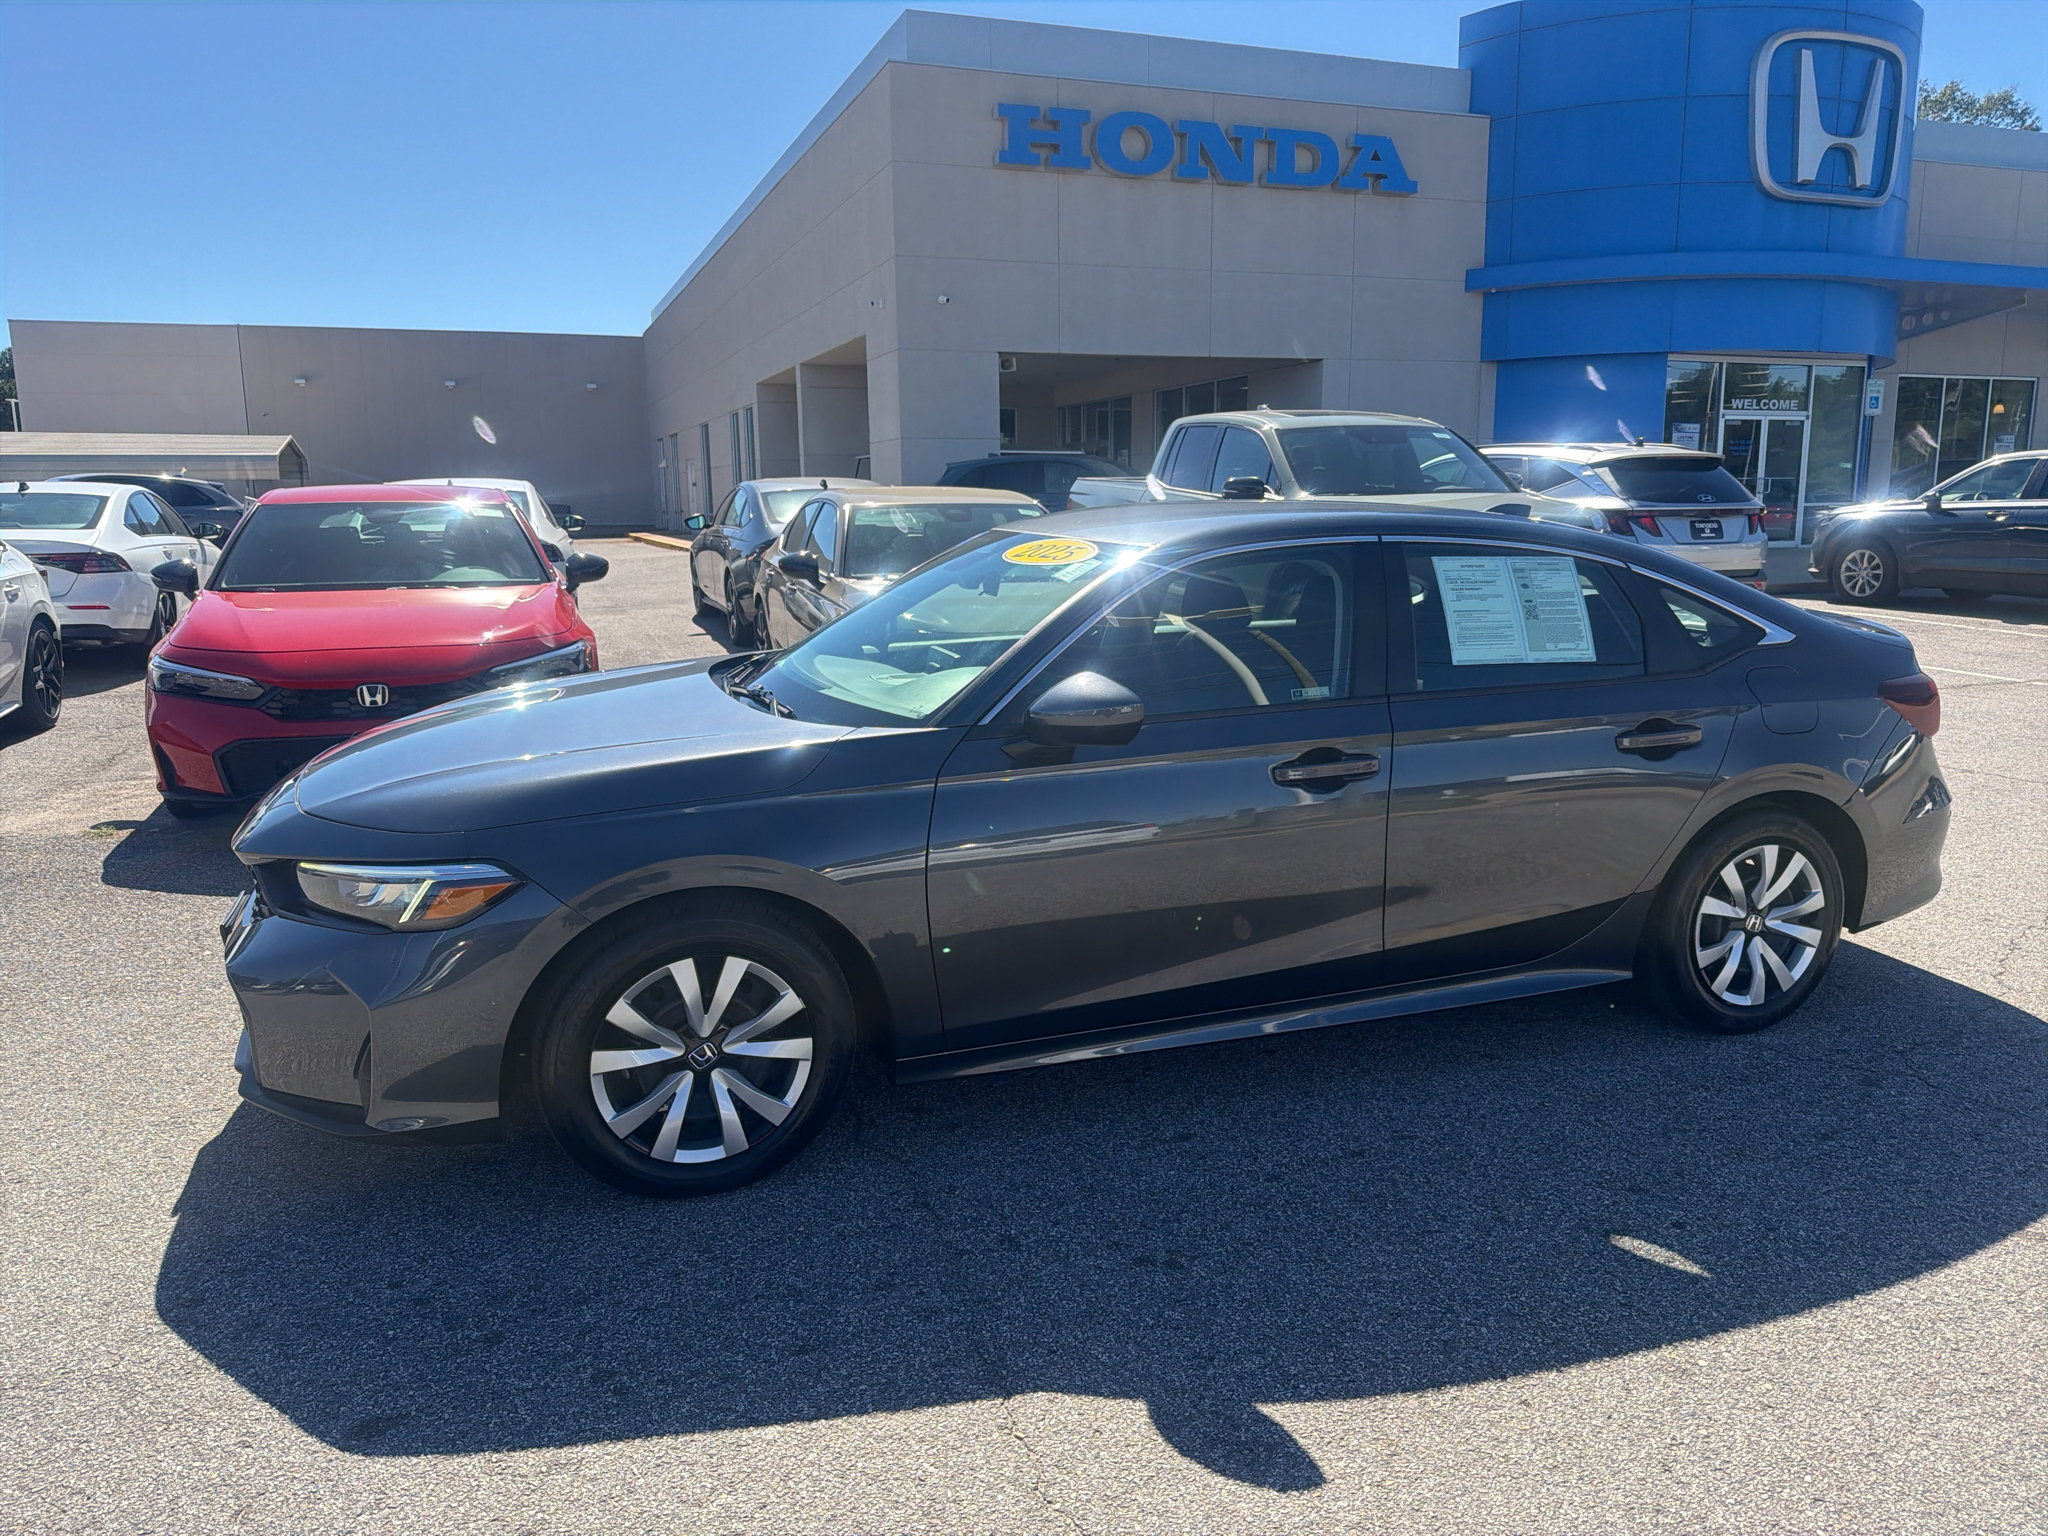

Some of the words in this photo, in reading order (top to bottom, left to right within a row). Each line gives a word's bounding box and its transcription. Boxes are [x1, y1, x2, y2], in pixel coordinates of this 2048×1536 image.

[996, 103, 1418, 195] HONDA
[1731, 398, 1799, 410] WELCOME
[1011, 543, 1088, 561] 2025
